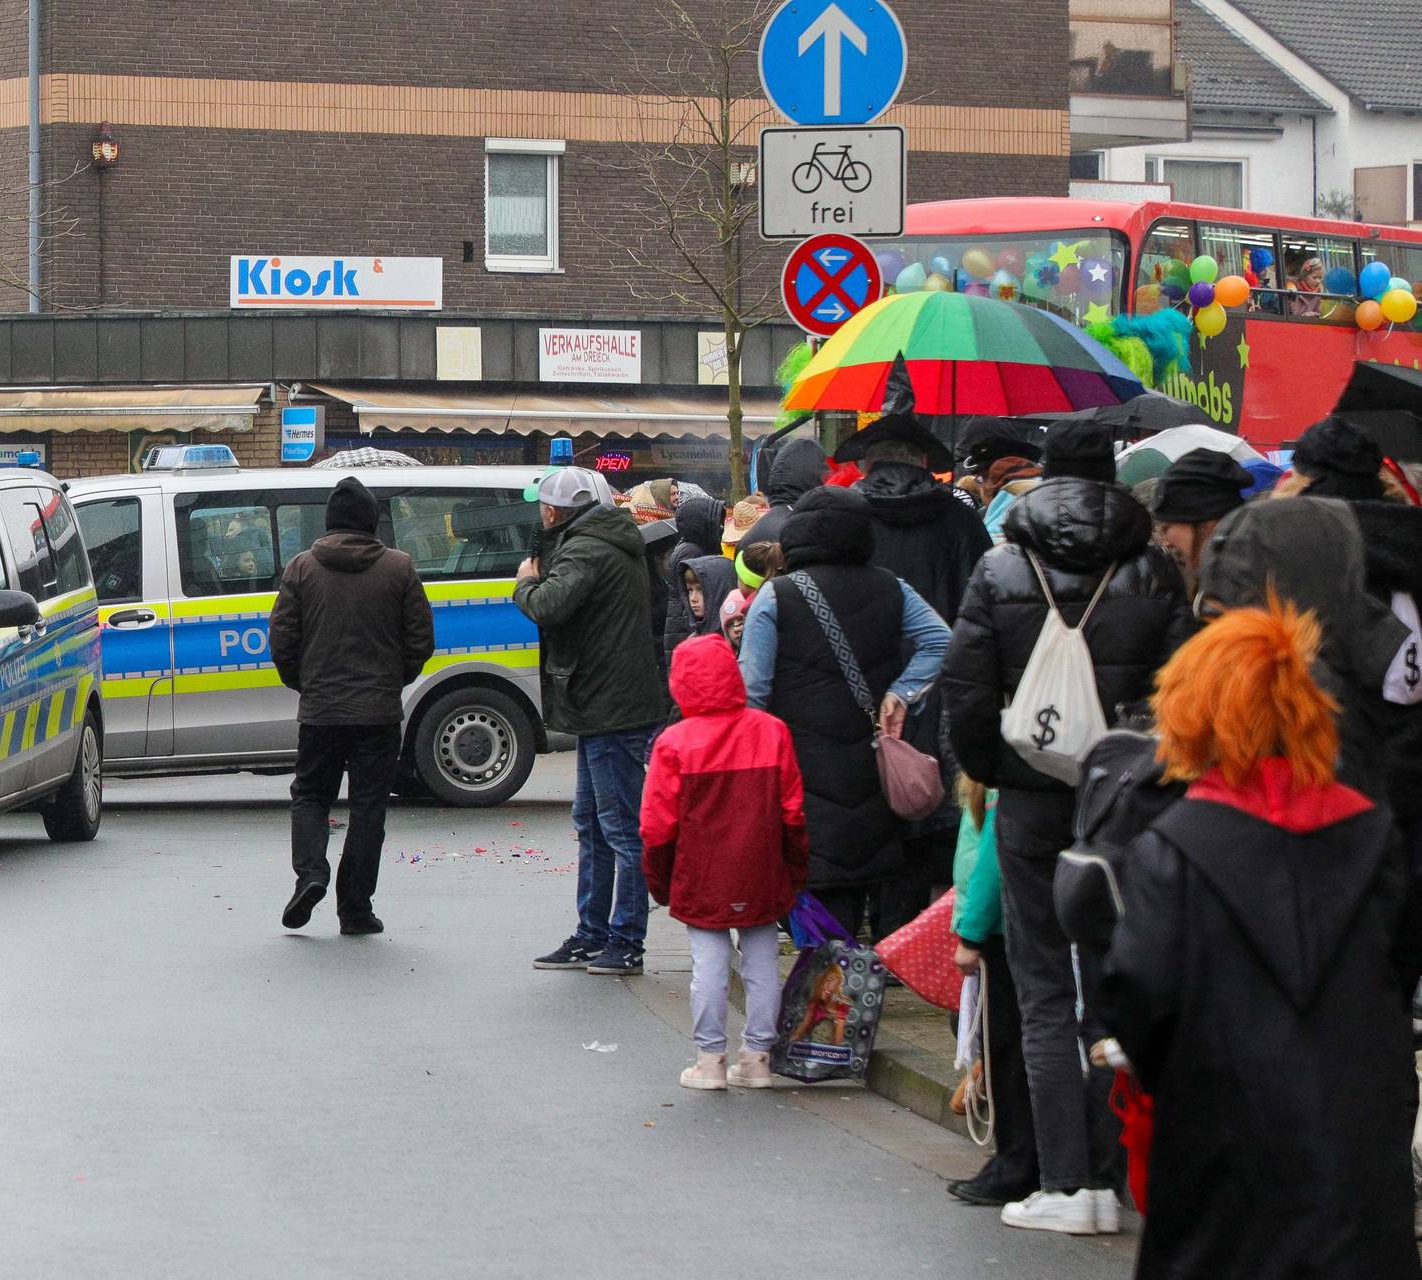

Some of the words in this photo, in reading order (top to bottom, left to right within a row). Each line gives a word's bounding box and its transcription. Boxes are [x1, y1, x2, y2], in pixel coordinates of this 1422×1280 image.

[811, 201, 853, 224] frei
[238, 257, 359, 297] Kiosk
[372, 258, 384, 273] &
[544, 334, 637, 358] VERKAUFSHALLE
[572, 353, 582, 362] AM
[584, 351, 610, 362] DREIECK
[291, 429, 314, 439] Hermes
[661, 448, 723, 461] Lycamobile
[219, 627, 271, 657] PO
[0, 654, 28, 690] POLIZEI
